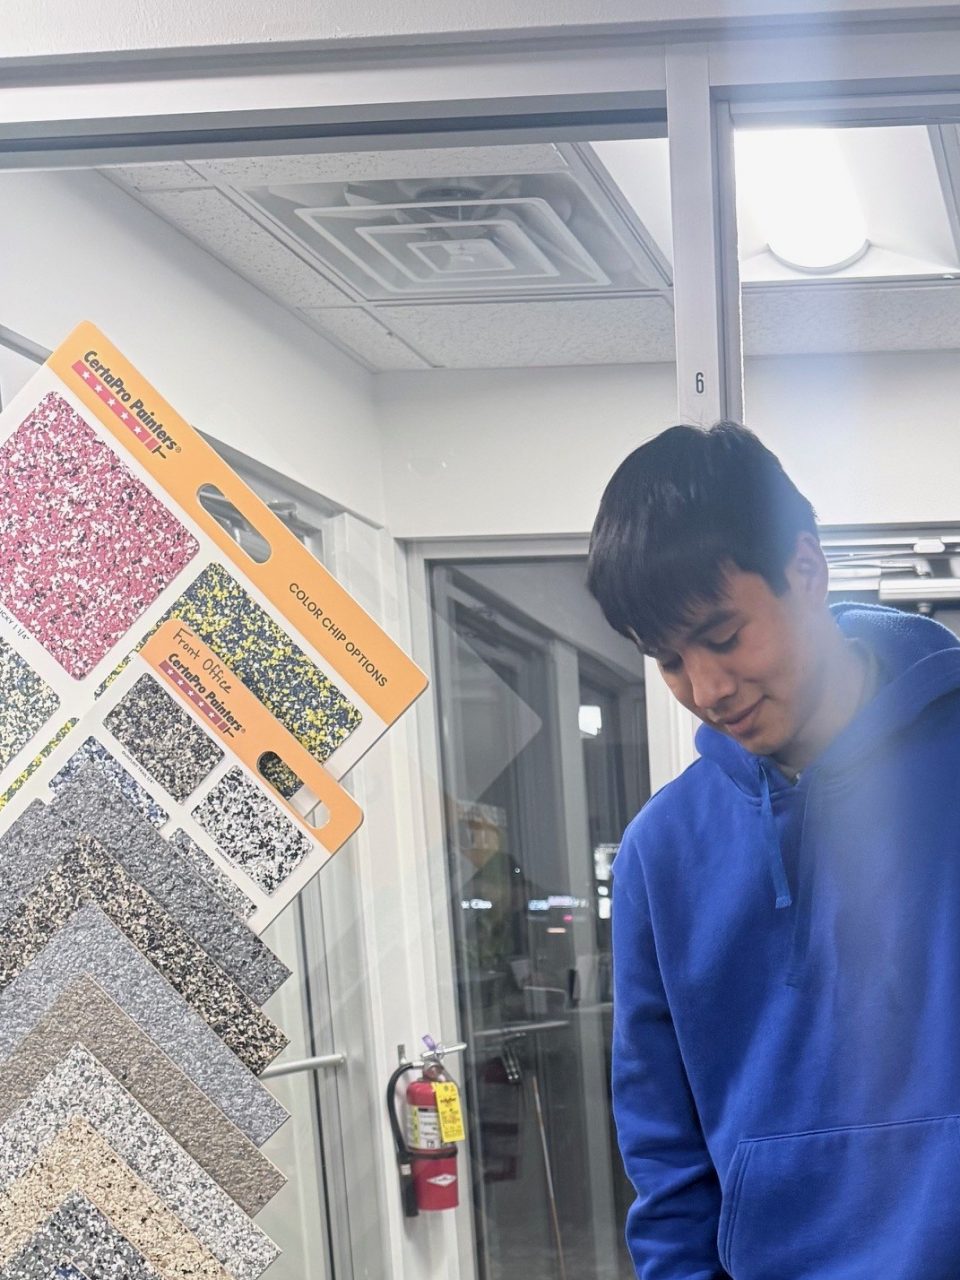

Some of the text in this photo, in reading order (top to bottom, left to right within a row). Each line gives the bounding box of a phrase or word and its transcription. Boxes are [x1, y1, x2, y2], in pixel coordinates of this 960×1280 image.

[84, 350, 131, 402] CertaPro
[695, 371, 705, 394] 6
[289, 582, 388, 687] COLOR CHIP OPTIONS
[168, 653, 206, 694] CertaPro
[173, 627, 232, 695] Front Office
